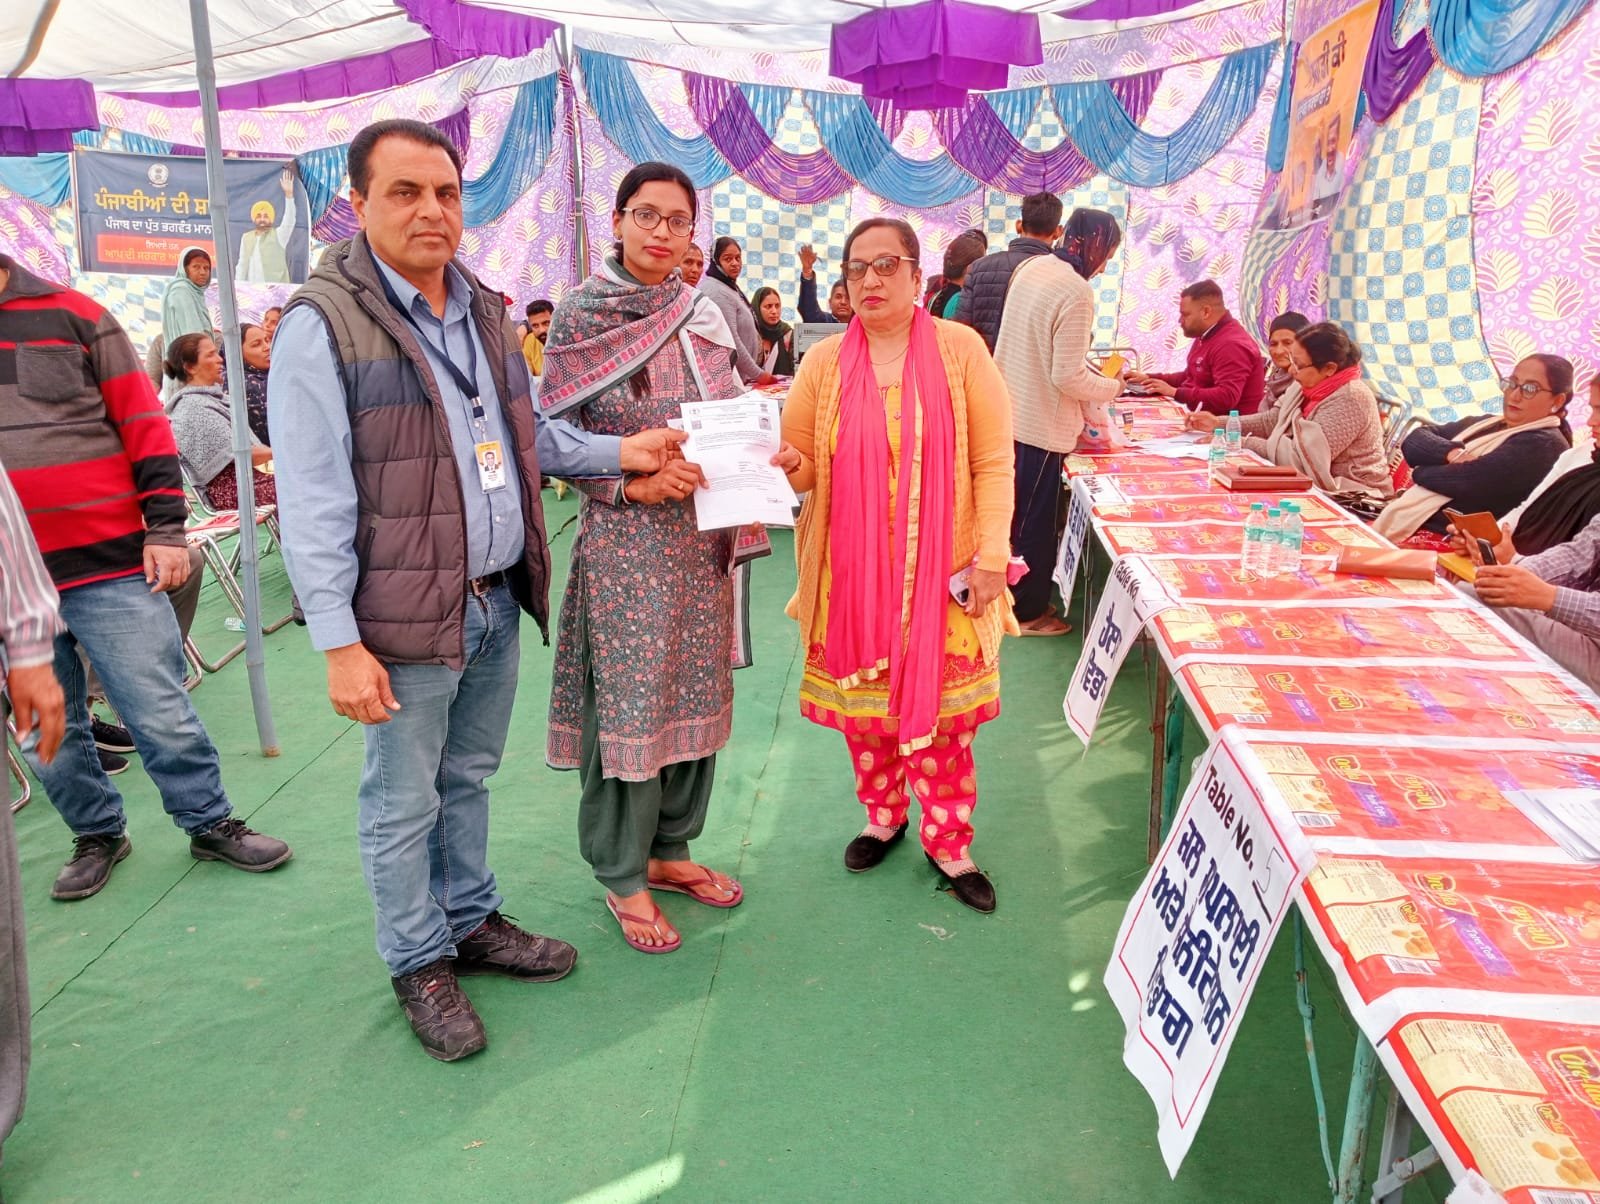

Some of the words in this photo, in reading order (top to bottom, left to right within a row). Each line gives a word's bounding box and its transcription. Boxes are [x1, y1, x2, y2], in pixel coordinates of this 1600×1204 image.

[94, 187, 167, 213] ਪੰਜਾਬੀਆਂ
[170, 191, 190, 215] ਦੀ
[104, 216, 130, 231] ਪੰਜਾਬ
[132, 220, 143, 231] ਦਾ
[1114, 560, 1134, 589] Table
[1204, 763, 1236, 830] Table
[1231, 815, 1254, 871] No.
[1177, 818, 1207, 878] ਜਲ
[1256, 846, 1285, 894] 5
[1151, 866, 1188, 933] ਅਤੇ
